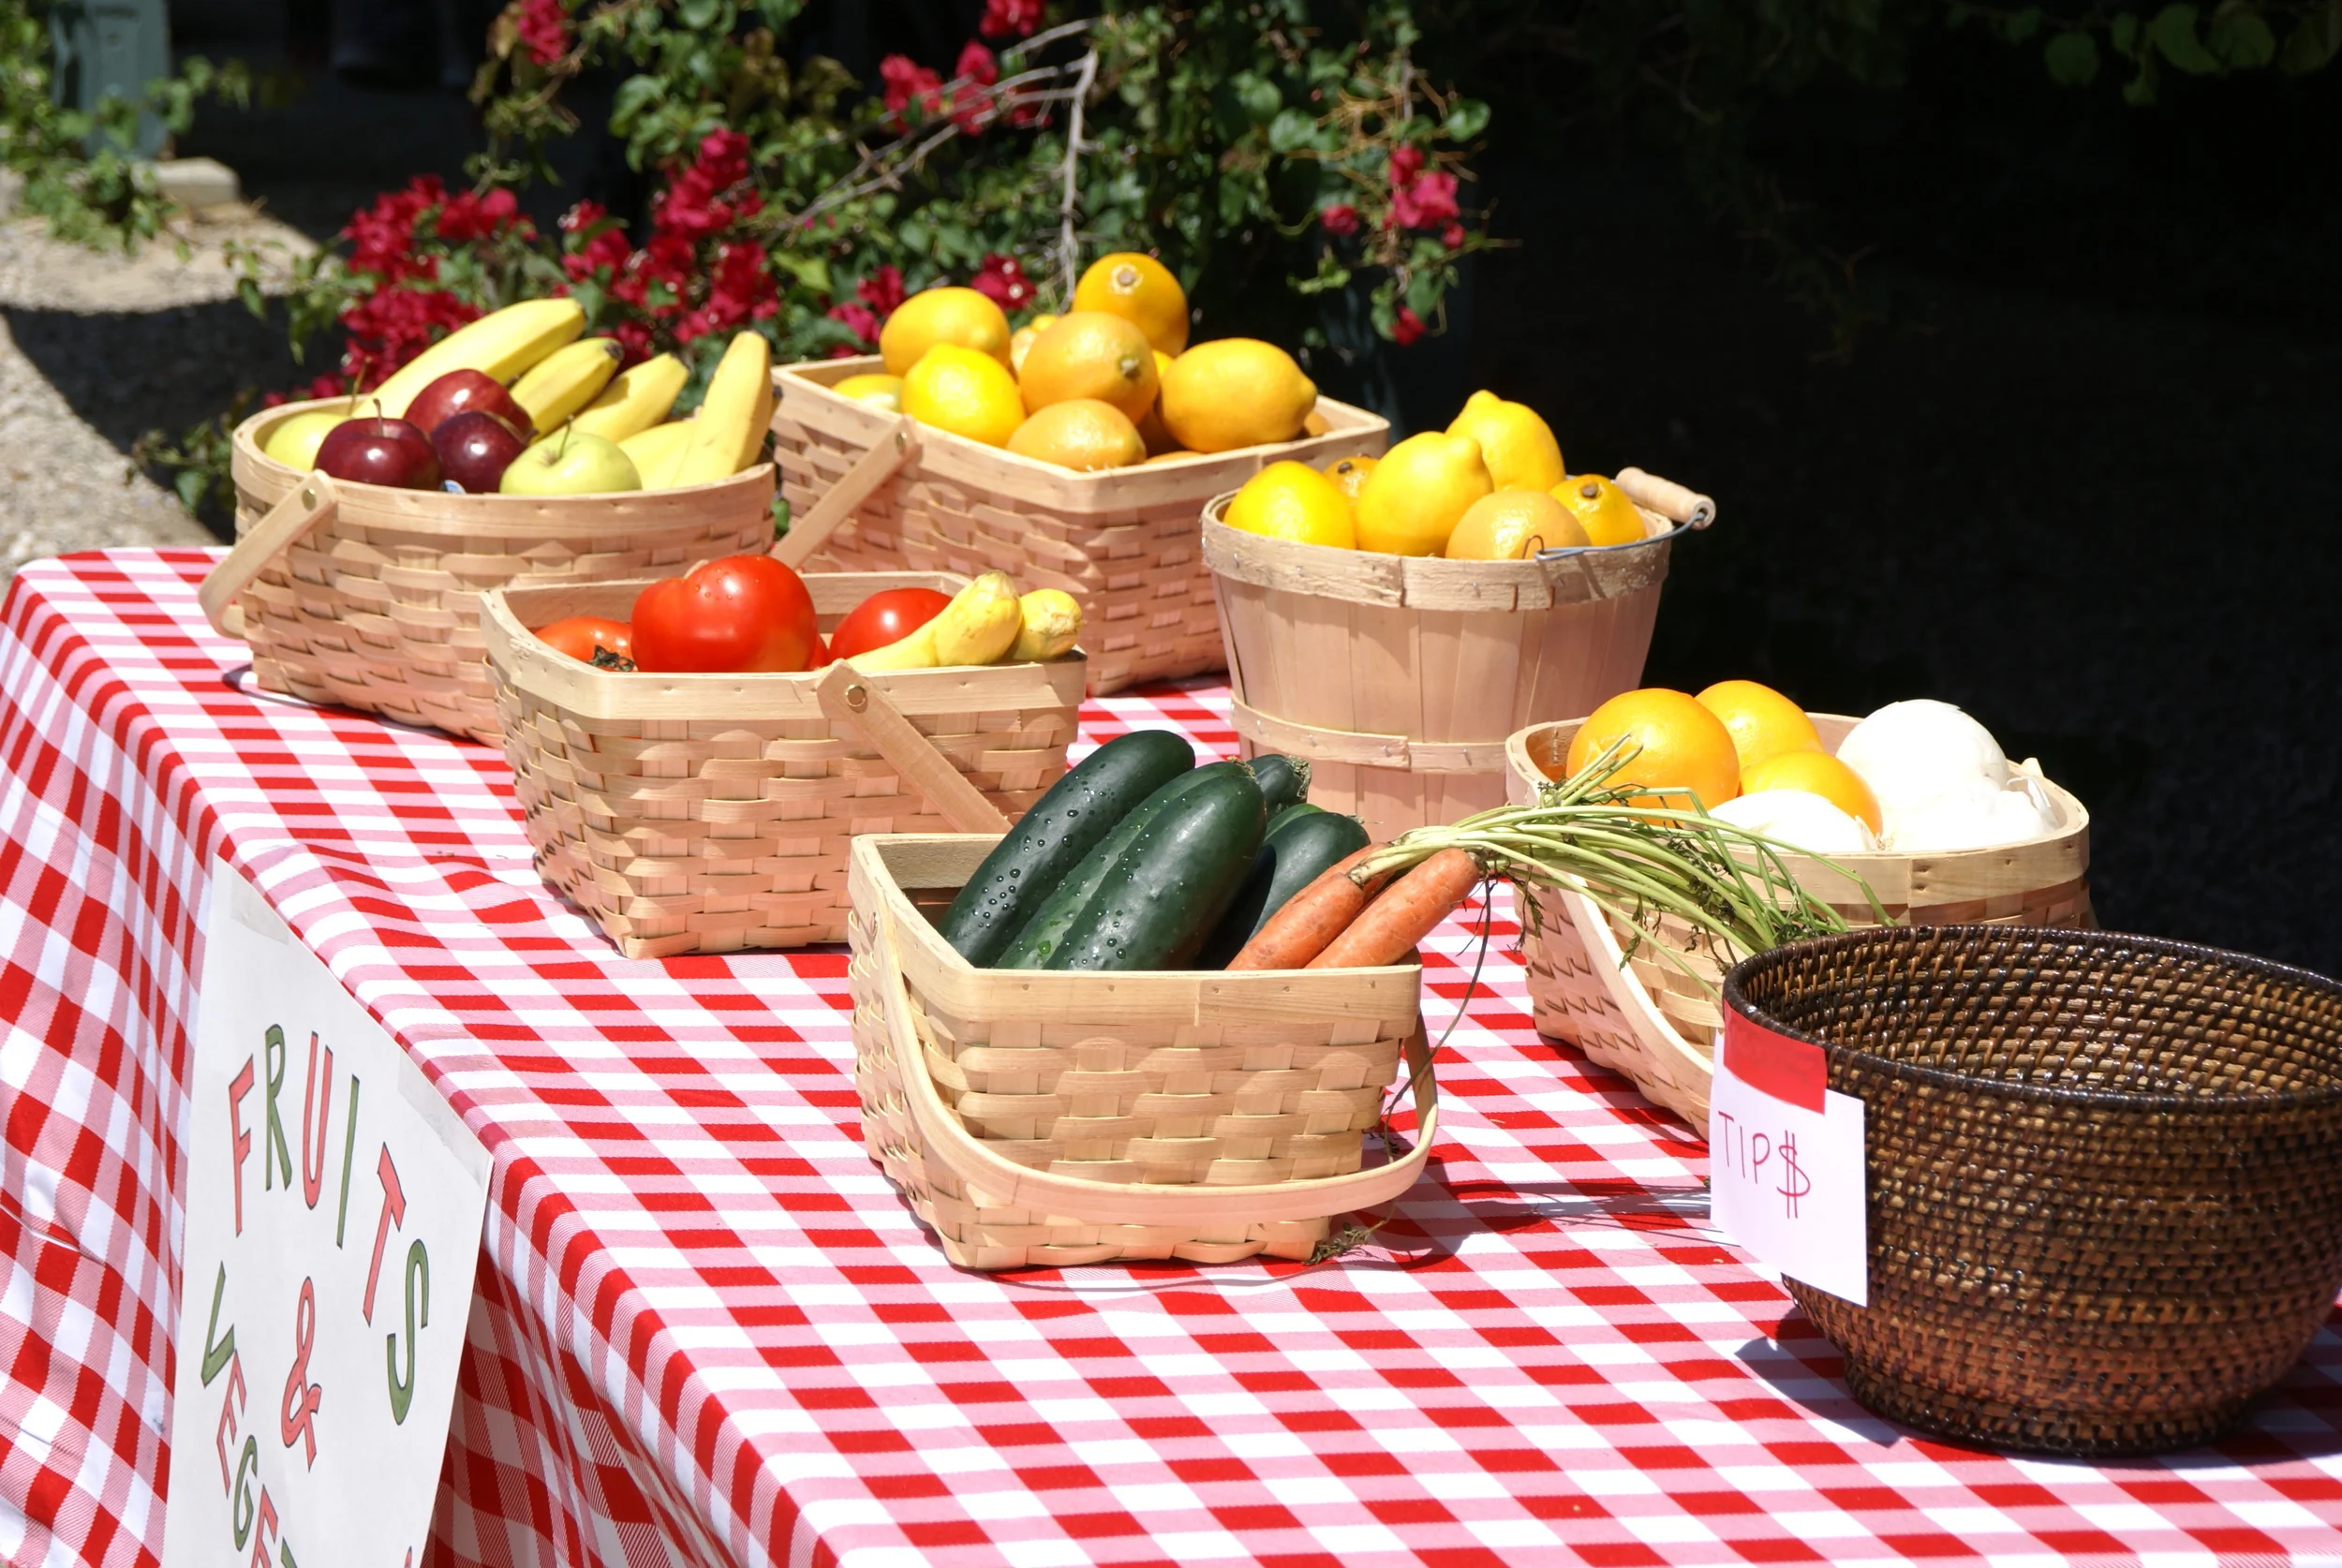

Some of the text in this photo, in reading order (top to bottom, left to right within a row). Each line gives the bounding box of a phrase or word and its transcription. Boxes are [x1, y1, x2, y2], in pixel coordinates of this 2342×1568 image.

[228, 1023, 430, 1426] FRUITS
[1717, 1110, 1812, 1220] TIP$
[280, 1275, 322, 1473] &
